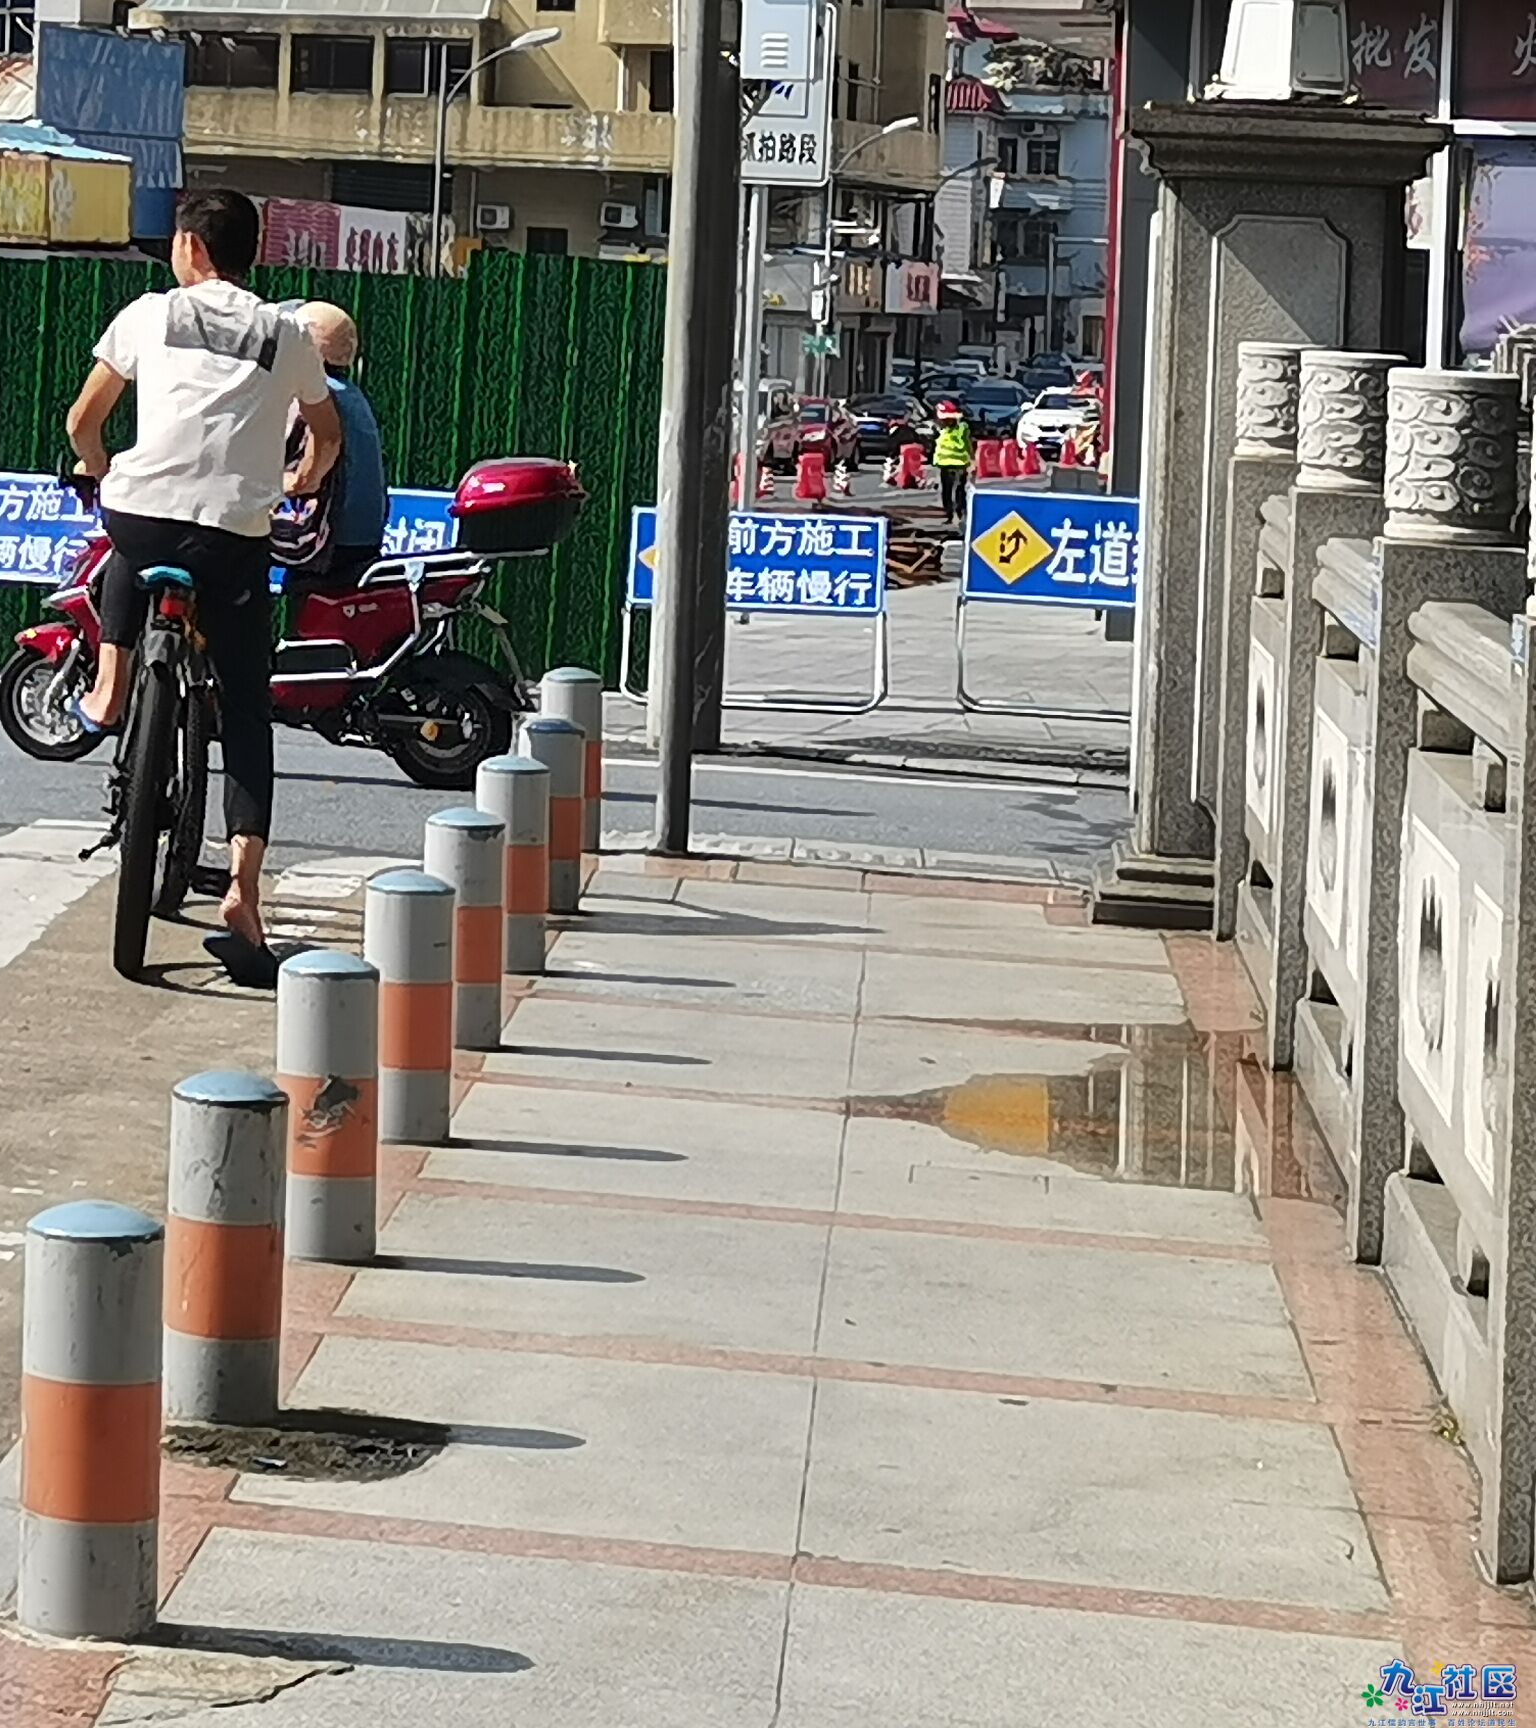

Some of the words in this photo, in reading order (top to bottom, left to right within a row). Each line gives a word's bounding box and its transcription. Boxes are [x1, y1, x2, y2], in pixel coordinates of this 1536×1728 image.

[1351, 13, 1438, 80] 批发
[729, 518, 875, 557] 前方施工
[1046, 518, 1139, 587] 左道
[726, 566, 872, 605] 车辆慢行
